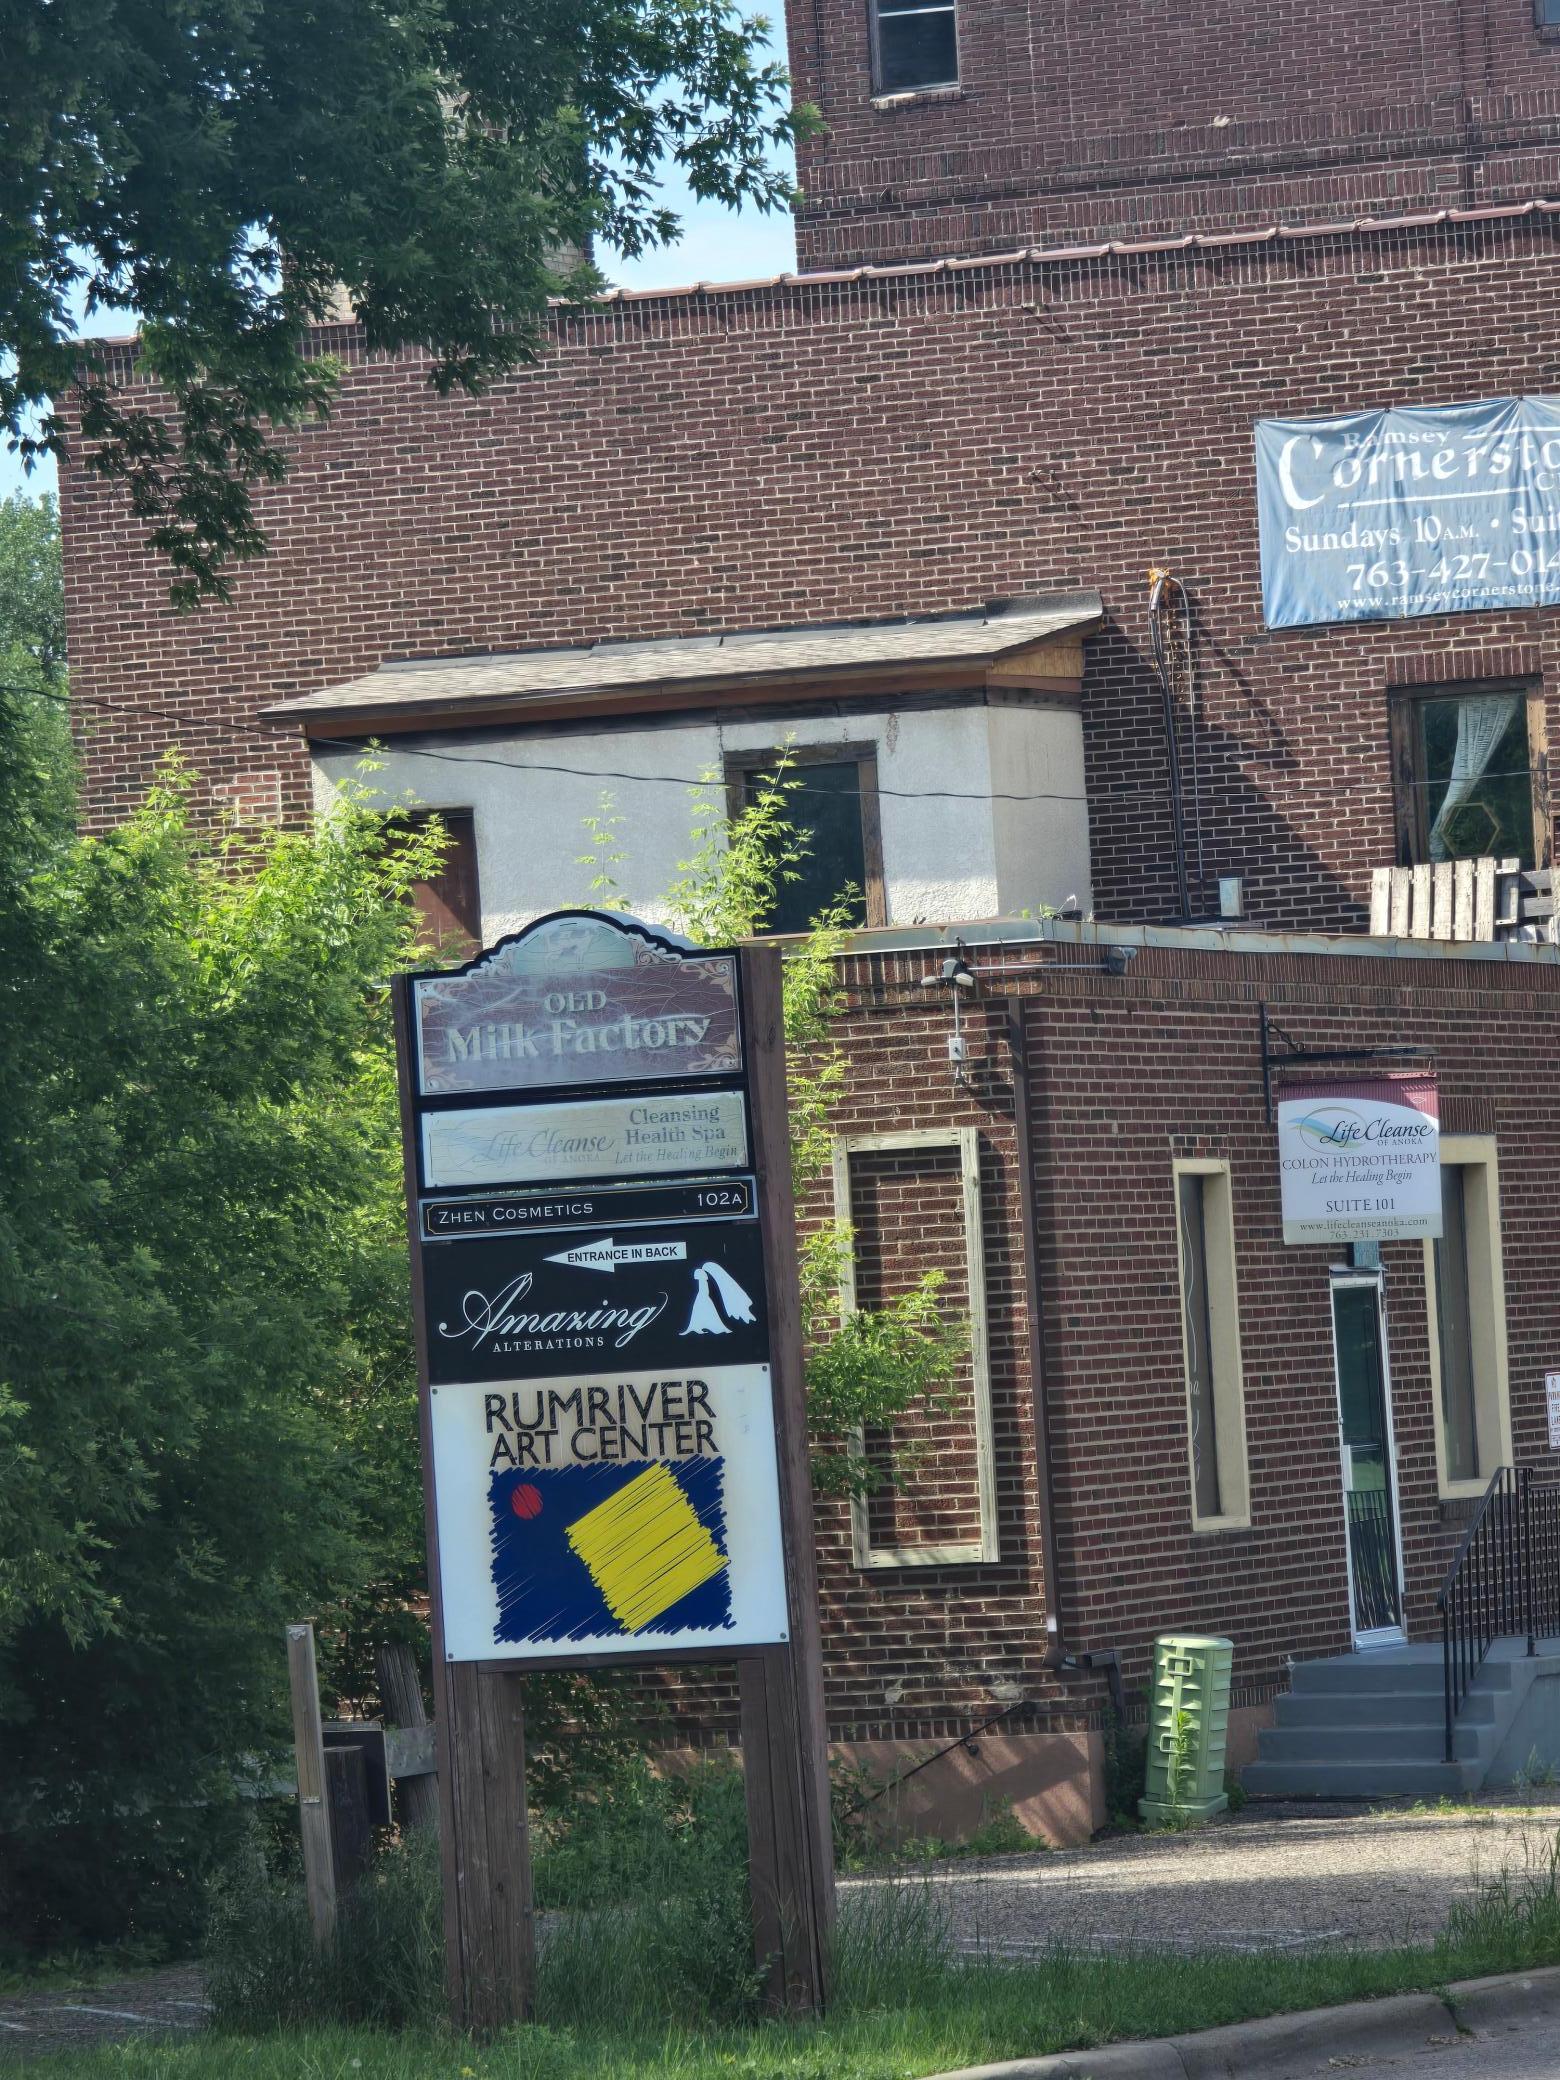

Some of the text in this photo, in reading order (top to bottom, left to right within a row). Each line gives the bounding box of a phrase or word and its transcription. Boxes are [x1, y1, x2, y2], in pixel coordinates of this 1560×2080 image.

[1343, 430, 1449, 450] Ramsey
[1285, 521, 1400, 552] Sundays
[543, 989, 607, 1014] OLD
[443, 1015, 713, 1063] Milk Factory
[629, 1105, 720, 1125] Cleansing
[625, 1126, 726, 1146] Health Spa
[1392, 1138, 1423, 1146] ANOKA
[705, 1144, 738, 1161] Begin
[1282, 1152, 1437, 1170] COLON HYDROTHERAPY
[1312, 1169, 1412, 1185] Let the Healing Begin
[493, 1203, 593, 1221] COSMETICS
[697, 1192, 742, 1206] 102A
[1326, 1198, 1396, 1212] SUITE 101
[567, 1246, 678, 1263] ENTRANCE IN BACK
[438, 1272, 669, 1351] Amazing
[493, 1336, 605, 1353] ALTERATIONS
[485, 1380, 717, 1433] RUMRIVER
[490, 1420, 721, 1467] ART CENTER
